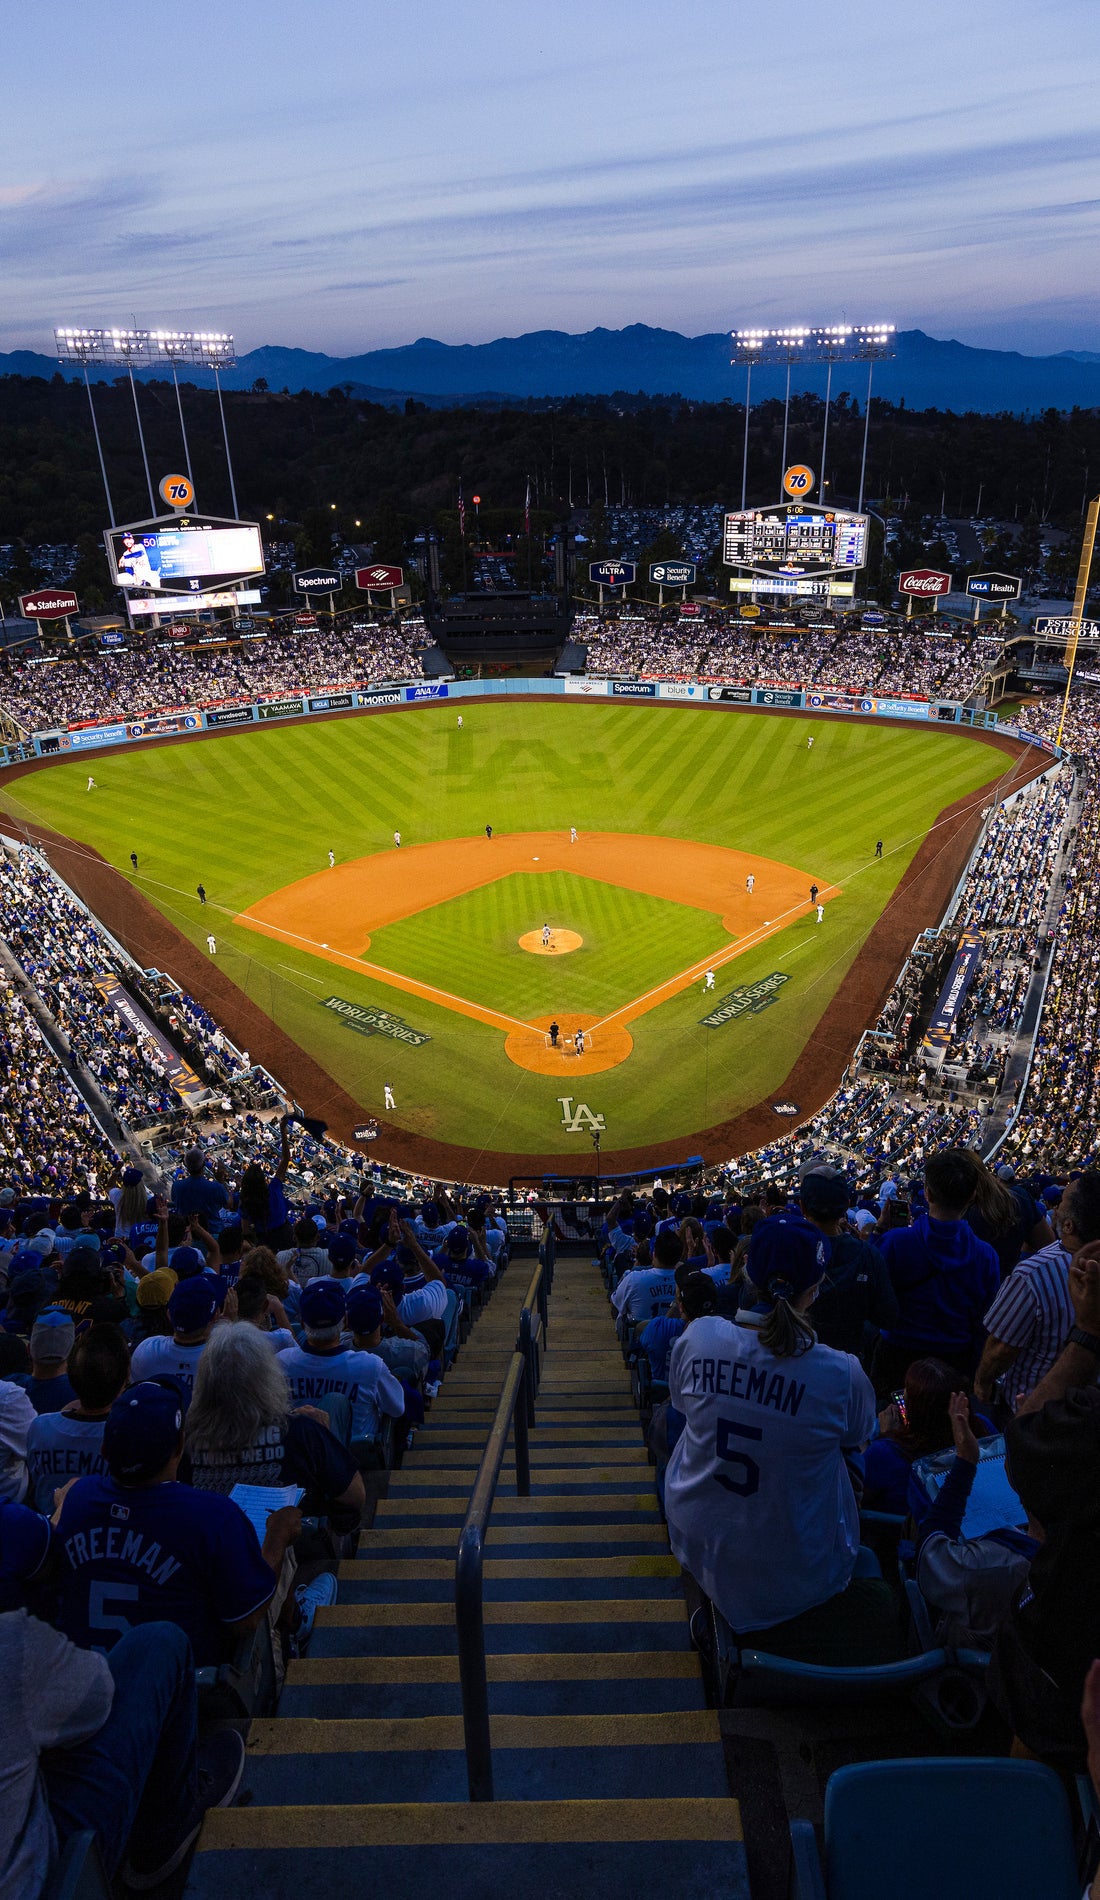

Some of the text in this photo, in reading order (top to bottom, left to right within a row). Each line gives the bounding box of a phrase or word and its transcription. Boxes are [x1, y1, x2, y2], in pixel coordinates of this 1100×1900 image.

[790, 474, 808, 488] 76
[170, 484, 188, 499] 76
[144, 538, 156, 547] 50
[666, 567, 691, 575] Security
[298, 577, 336, 588] Spectrum
[990, 584, 1015, 592] Health
[172, 627, 187, 635] JINRO
[614, 684, 650, 693] Spectrum
[668, 686, 686, 694] blue
[364, 694, 400, 705] MORTON
[887, 704, 907, 713] Security
[81, 730, 123, 743] Security Benefit
[704, 997, 752, 1025] WORLD
[746, 974, 788, 999] SERIES
[326, 998, 426, 1045] WORLD SERIES
[557, 1096, 606, 1132] LA
[650, 1285, 676, 1298] OHTA
[290, 1378, 359, 1403] LENZUELA
[692, 1358, 806, 1417] FREEMAN
[241, 1450, 262, 1463] WE
[265, 1445, 285, 1461] DO
[714, 1417, 763, 1498] 5
[64, 1527, 184, 1587] FREEMAN
[88, 1580, 139, 1657] 5
